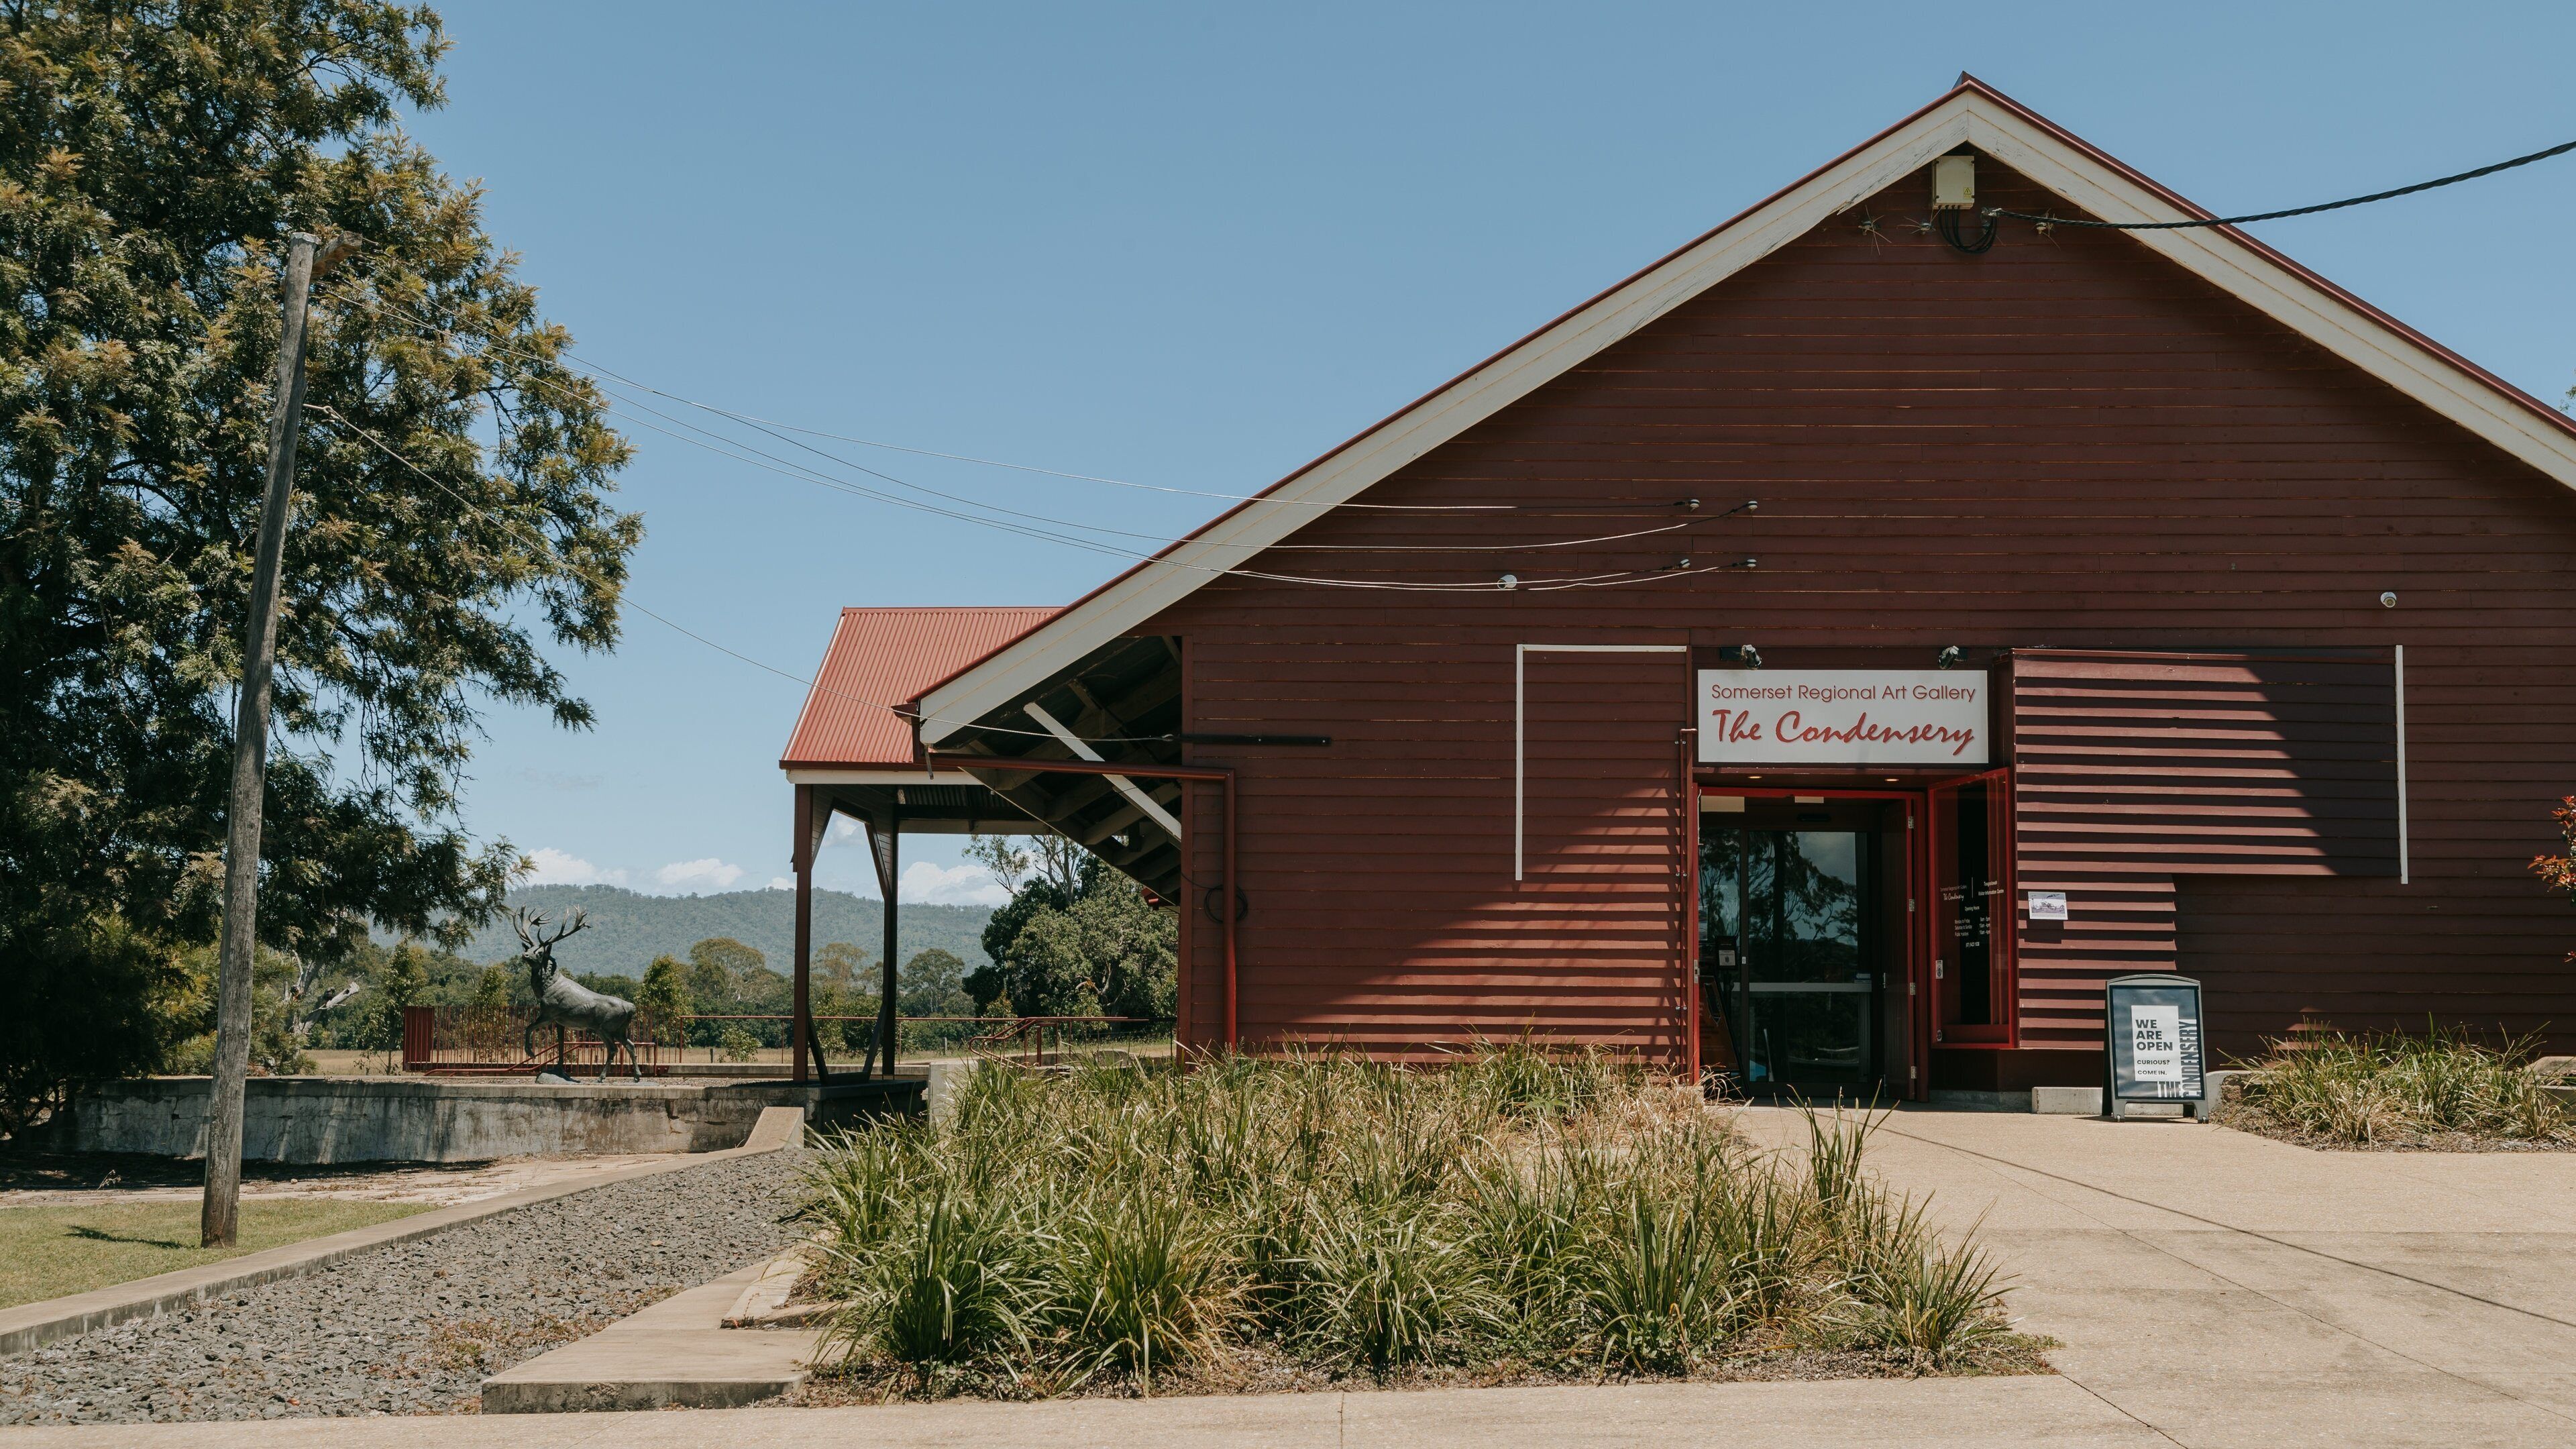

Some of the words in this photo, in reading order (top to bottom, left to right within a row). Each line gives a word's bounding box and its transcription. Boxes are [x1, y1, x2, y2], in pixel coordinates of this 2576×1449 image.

[1711, 684, 1792, 699] Somerset
[1798, 685, 1876, 702] Regional
[1882, 685, 1907, 699] Art
[1913, 685, 1976, 702] Gallery
[1712, 709, 1762, 743] The
[1775, 710, 1974, 756] Condensery
[2135, 1020, 2157, 1028] WE
[2136, 1030, 2162, 1040] ARE
[2137, 1042, 2173, 1051] OPEN
[2178, 1020, 2201, 1097] CONDENSERY
